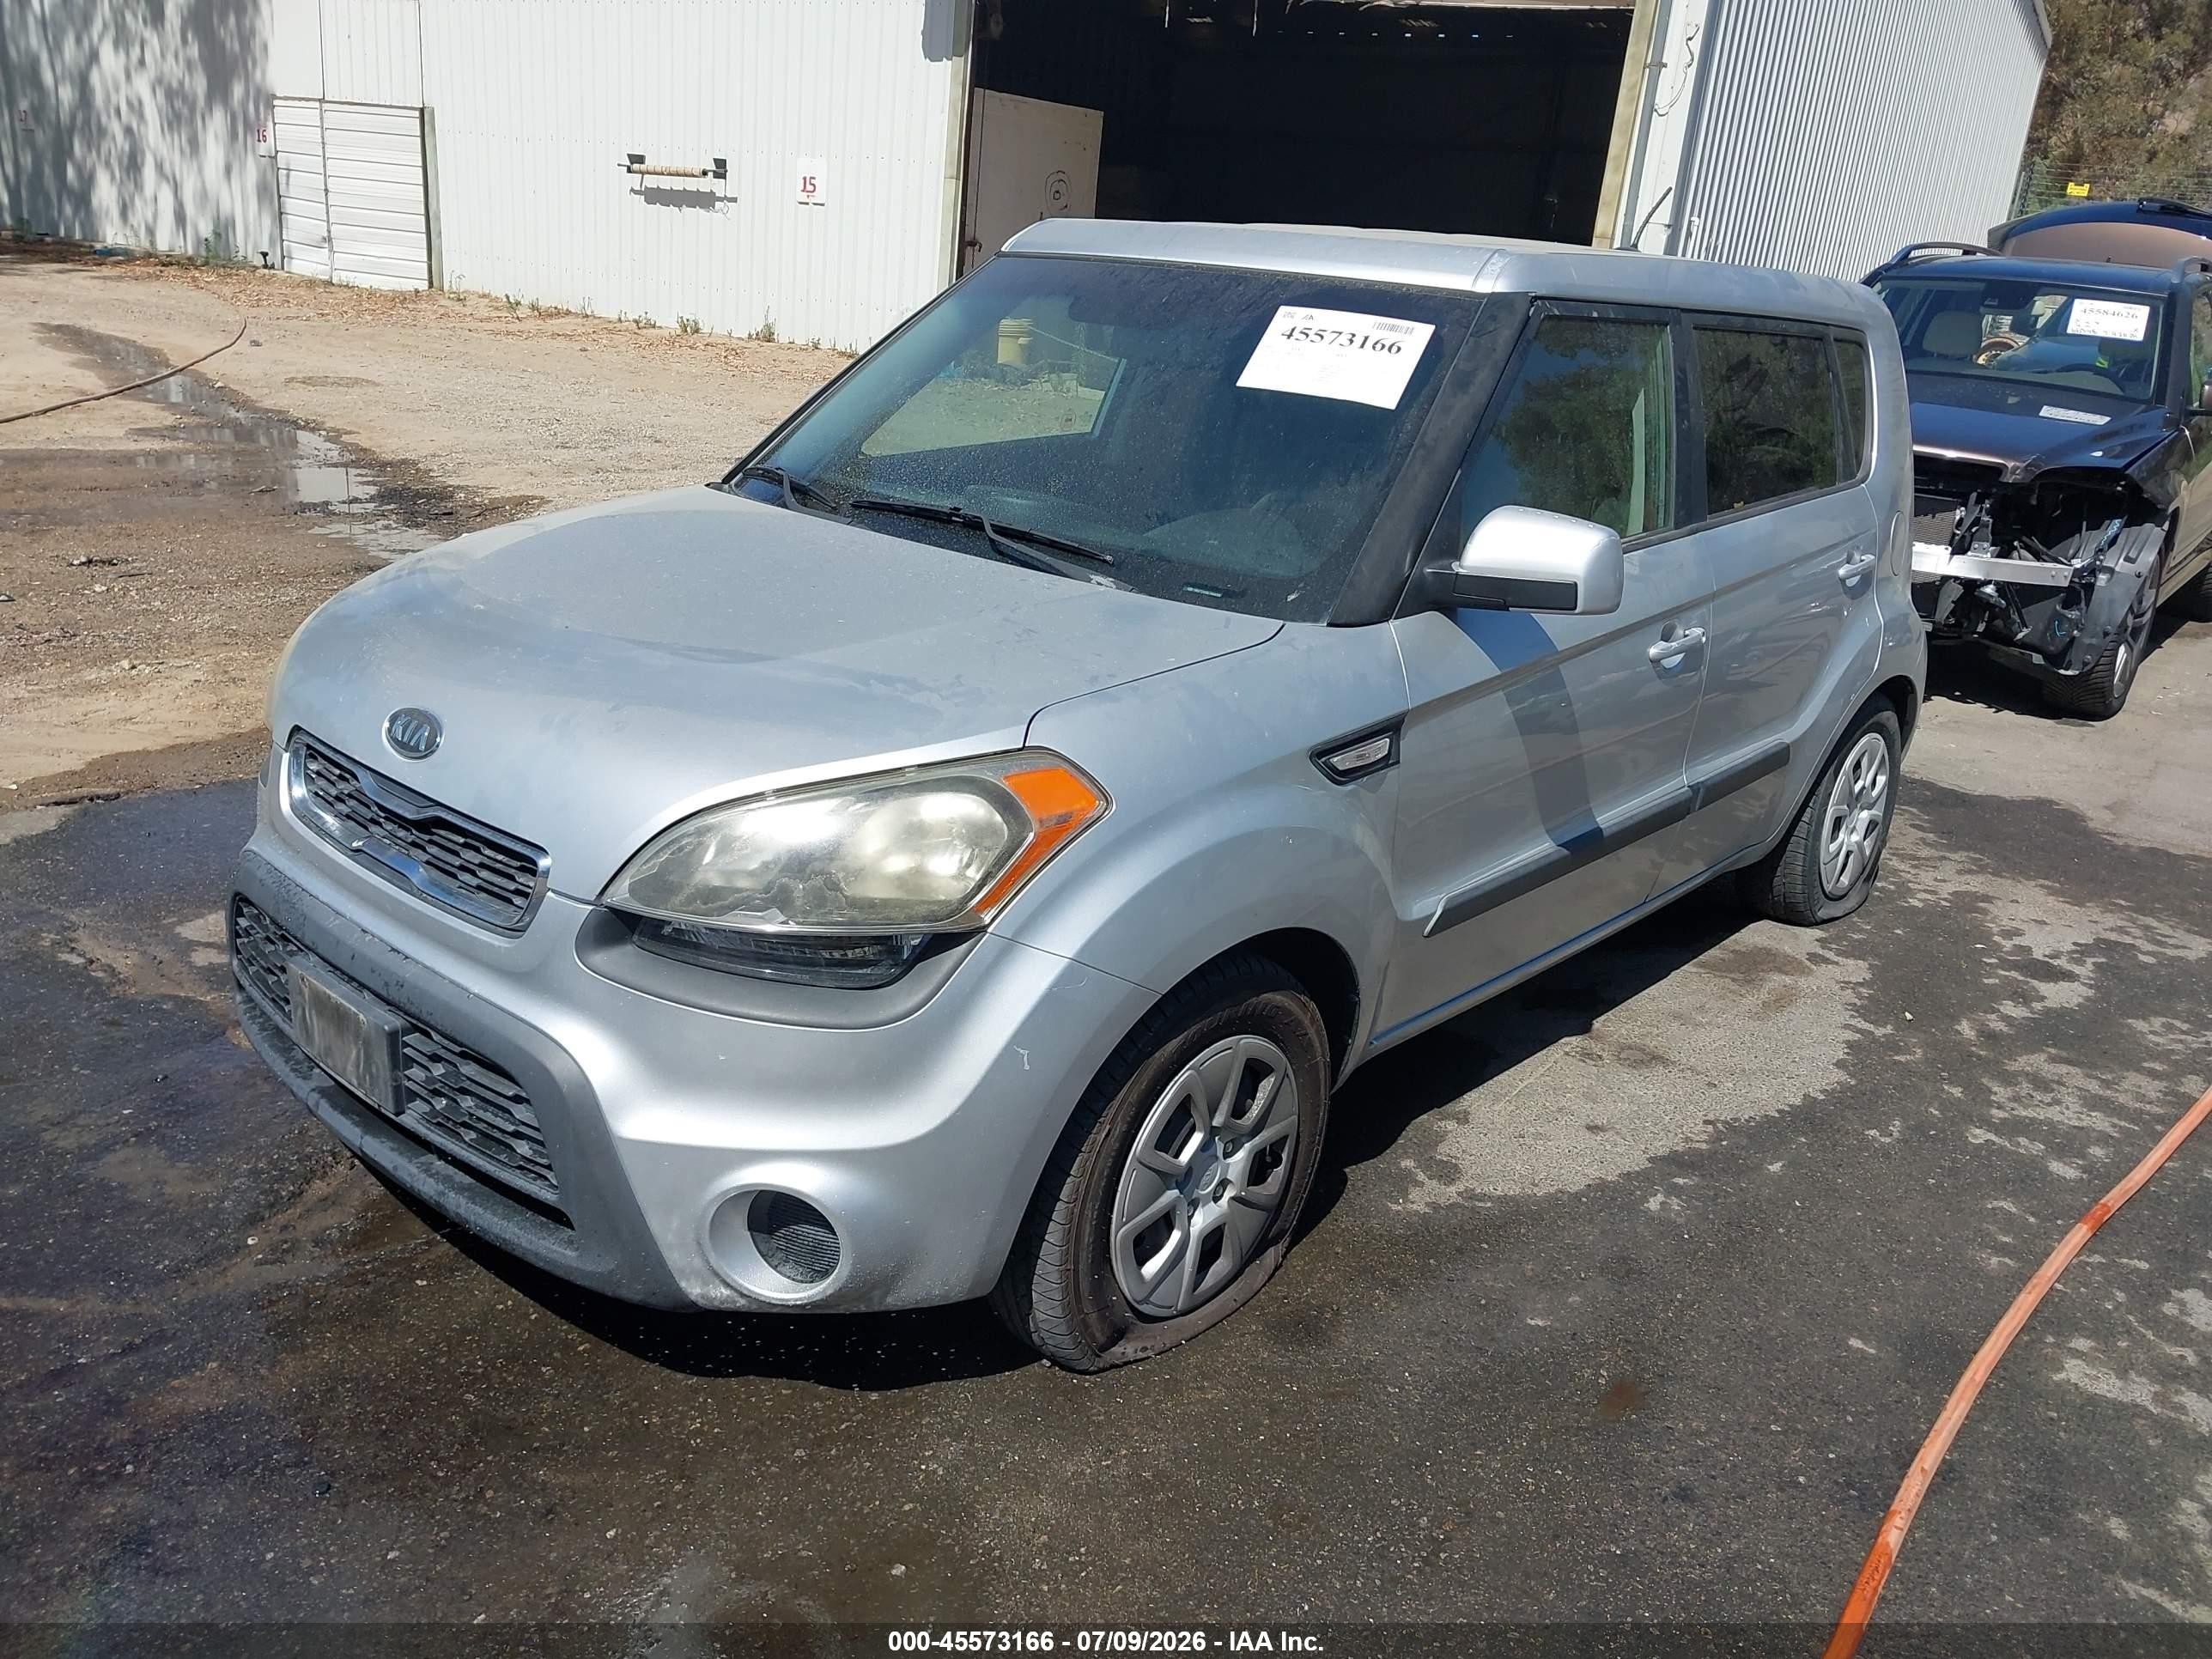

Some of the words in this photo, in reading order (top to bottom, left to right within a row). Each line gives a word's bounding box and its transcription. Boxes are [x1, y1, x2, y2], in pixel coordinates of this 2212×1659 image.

[257, 129, 268, 143] 16
[800, 176, 817, 193] 15
[1281, 326, 1403, 356] 45573166
[390, 714, 430, 751] KIA
